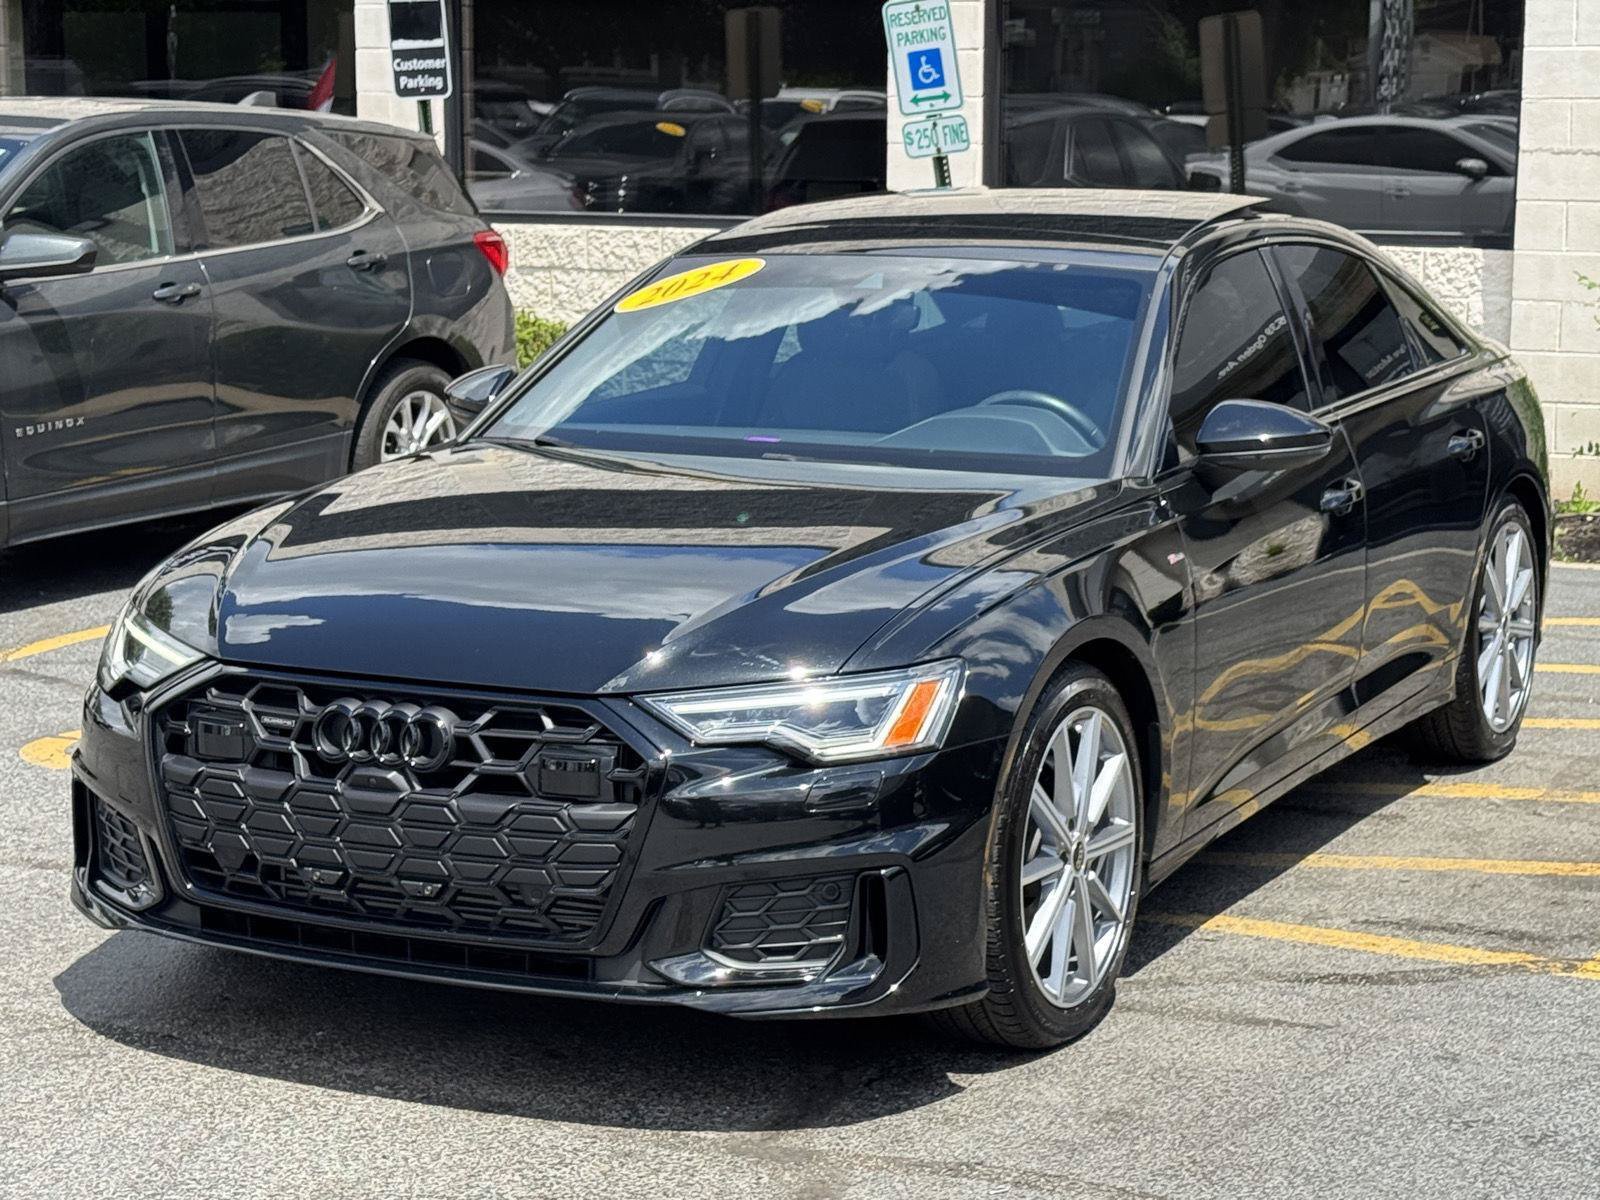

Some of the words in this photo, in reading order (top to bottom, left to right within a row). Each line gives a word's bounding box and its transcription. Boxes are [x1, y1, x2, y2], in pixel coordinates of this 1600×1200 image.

[889, 6, 947, 27] RESERVED
[896, 26, 947, 47] PARKING
[393, 58, 446, 71] Customer
[399, 74, 444, 90] Parking
[905, 127, 939, 149] $250
[942, 122, 969, 146] FINE
[636, 262, 741, 307] 2024
[15, 416, 85, 438] EQUINOX
